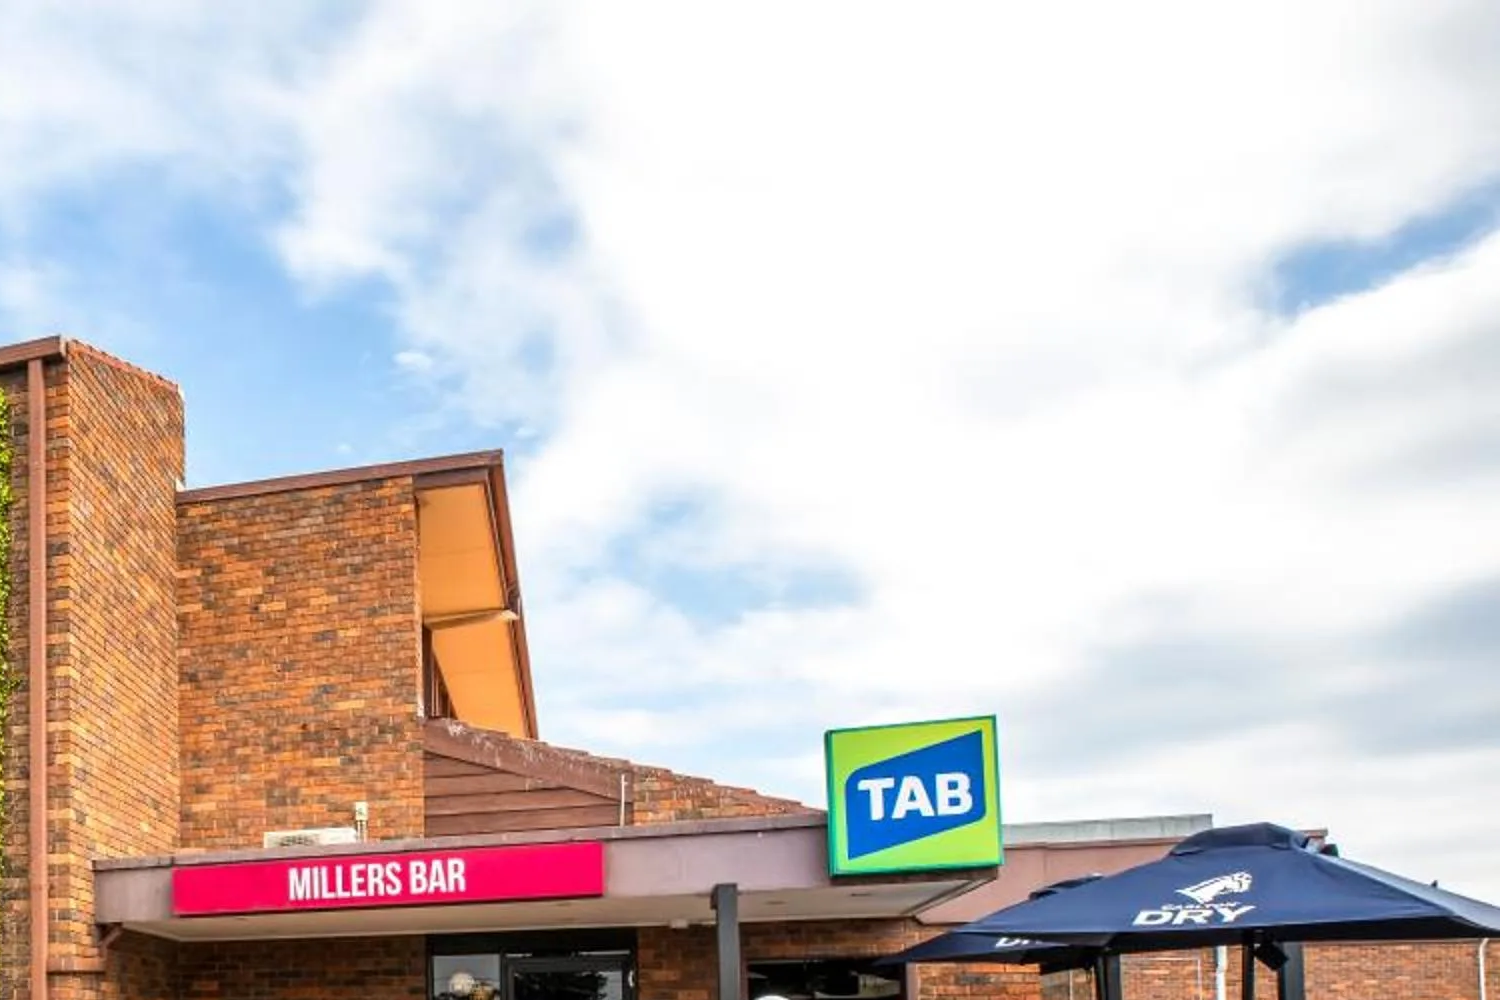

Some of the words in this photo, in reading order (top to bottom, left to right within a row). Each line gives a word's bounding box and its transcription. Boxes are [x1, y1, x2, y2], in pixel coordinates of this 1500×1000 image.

[857, 772, 974, 822] TAB
[288, 861, 403, 901] MILLERS
[409, 857, 467, 895] BAR
[1132, 905, 1256, 926] DRY
